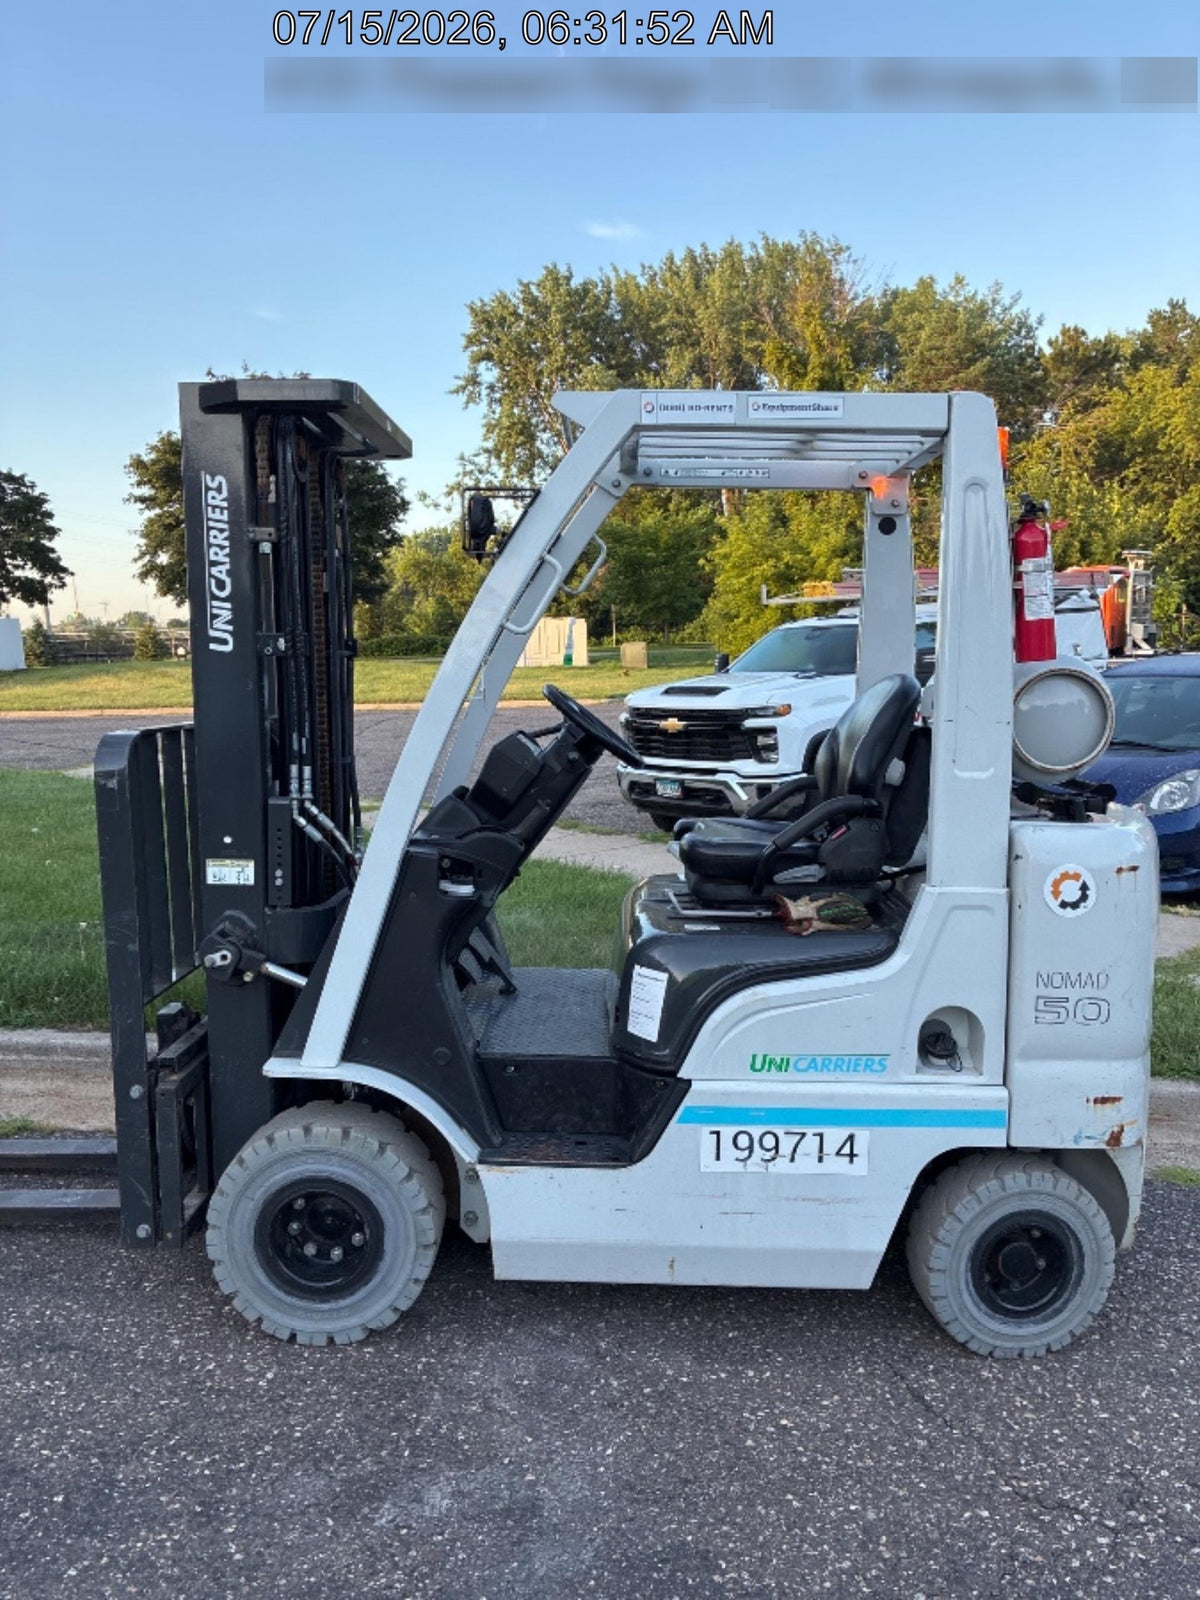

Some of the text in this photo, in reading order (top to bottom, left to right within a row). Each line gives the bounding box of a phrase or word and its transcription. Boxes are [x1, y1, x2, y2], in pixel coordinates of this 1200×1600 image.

[204, 473, 235, 652] UNICARRIERS
[1036, 971, 1109, 990] NOMAD
[1034, 995, 1110, 1026] 50
[709, 1129, 860, 1165] 199714
